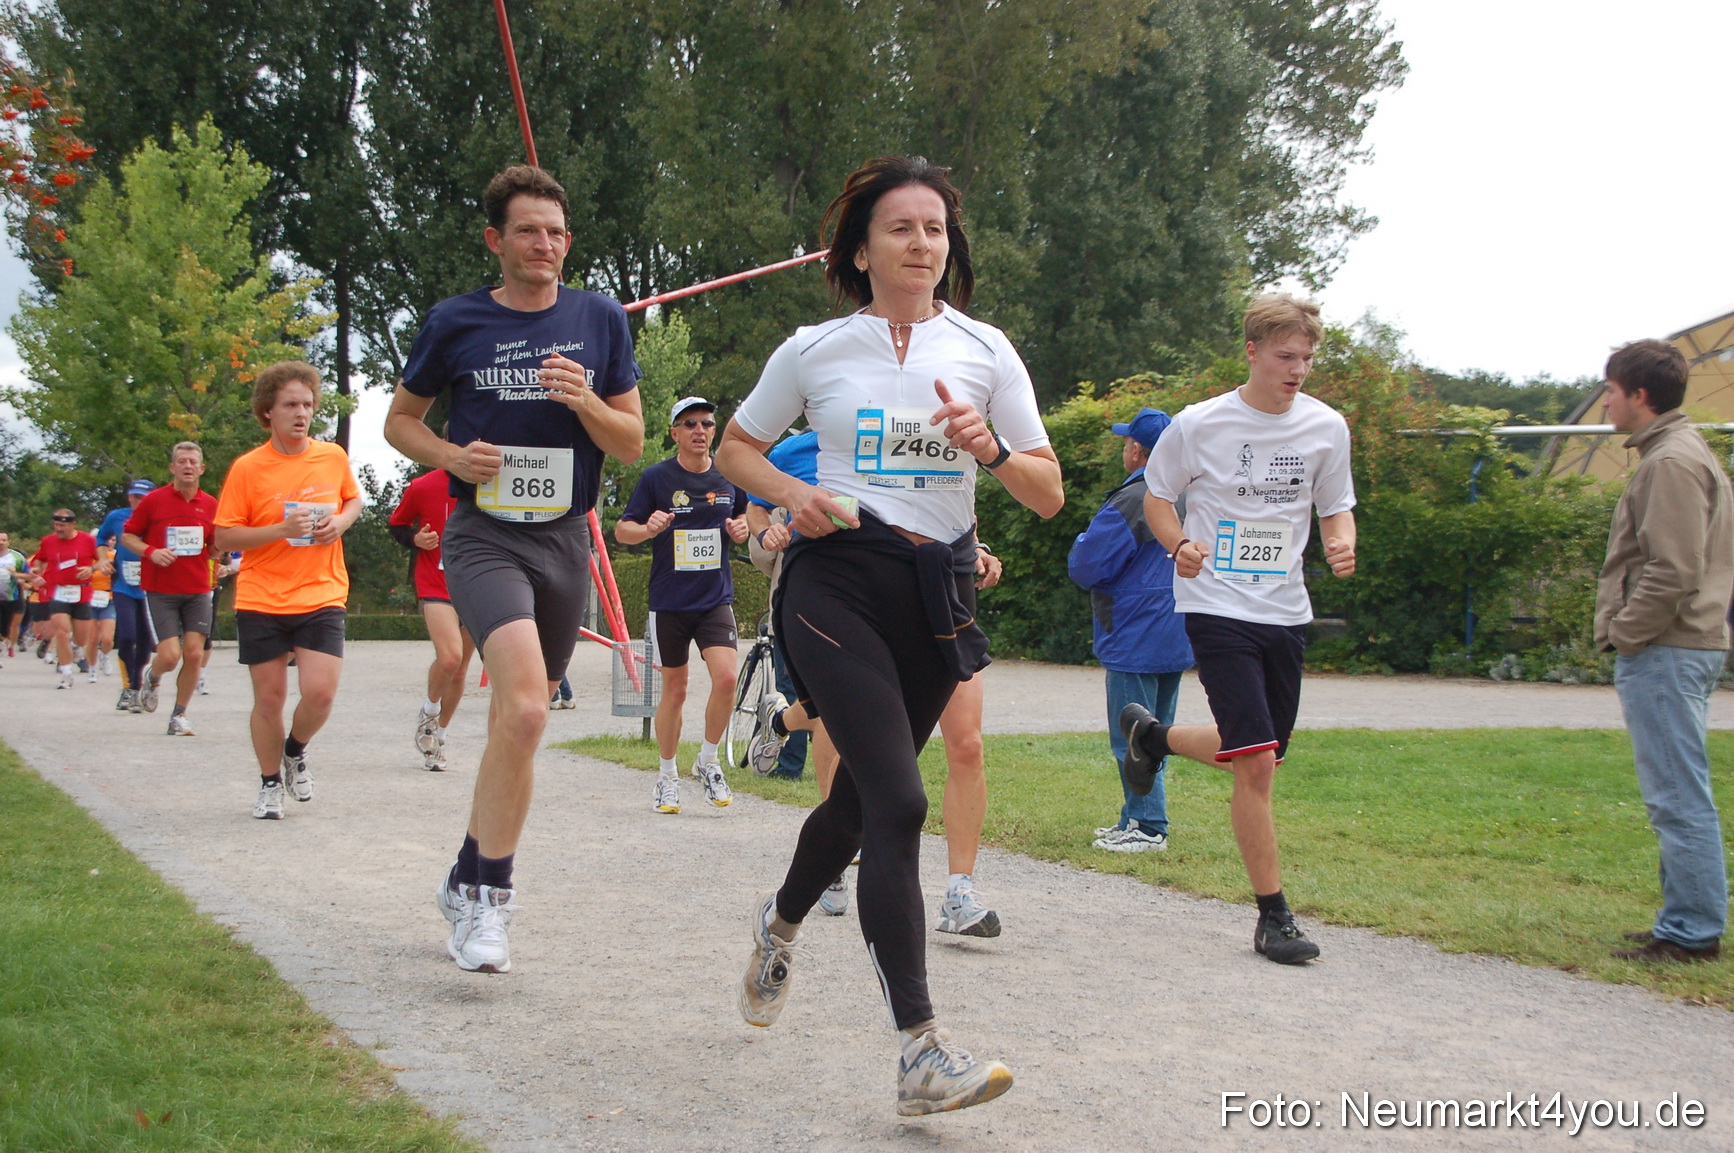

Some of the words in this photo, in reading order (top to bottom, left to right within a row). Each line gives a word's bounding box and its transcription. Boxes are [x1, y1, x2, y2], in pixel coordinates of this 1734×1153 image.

[494, 351, 512, 367] auf
[512, 350, 533, 361] dem
[535, 341, 584, 357] Laufenden!
[495, 339, 528, 352] Immer
[473, 366, 595, 387] NÜRNBR
[891, 416, 921, 437] Inge
[890, 438, 959, 462] 2466
[503, 453, 548, 469] Michael
[511, 477, 556, 498] 868
[687, 533, 714, 542] Gerhard
[1240, 527, 1282, 539] Johannes
[692, 545, 715, 557] 862
[1239, 545, 1283, 562] 2287
